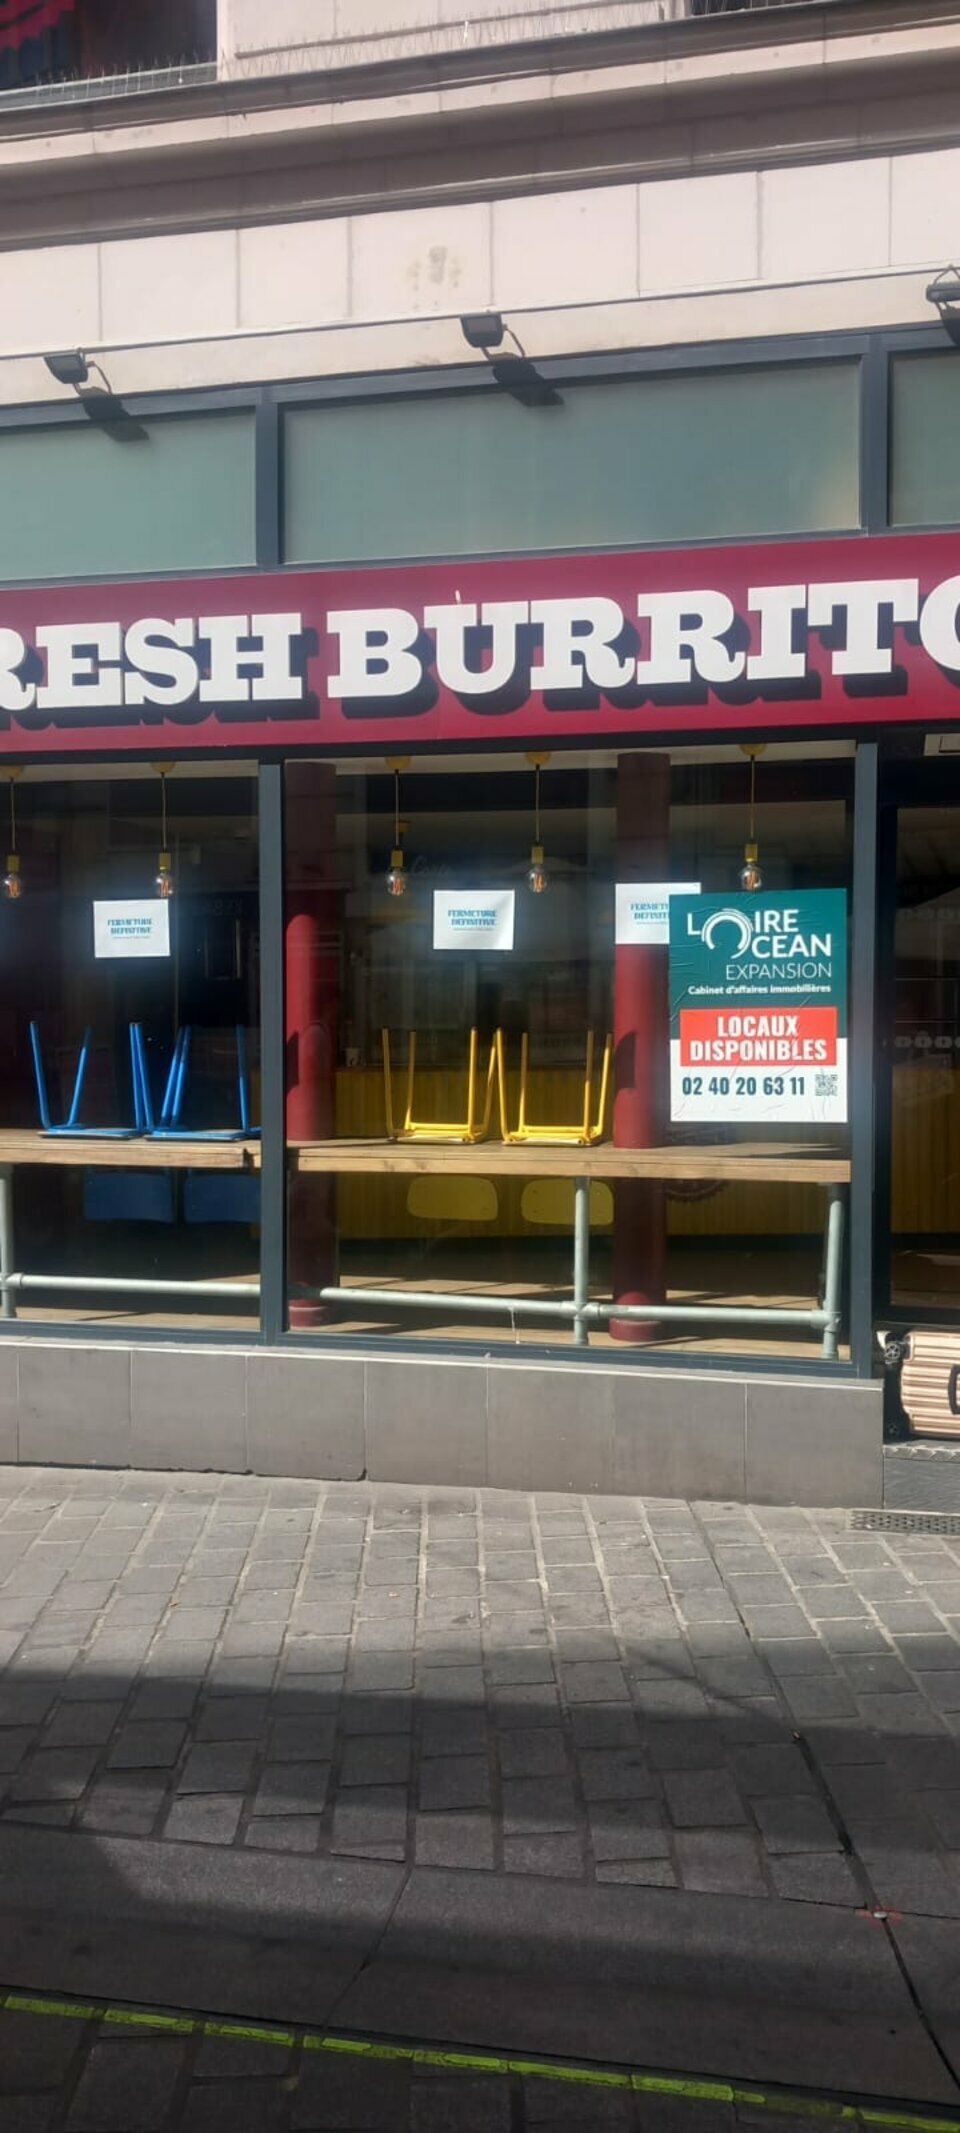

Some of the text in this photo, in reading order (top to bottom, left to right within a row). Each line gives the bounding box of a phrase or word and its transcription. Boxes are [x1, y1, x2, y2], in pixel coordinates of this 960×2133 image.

[107, 917, 152, 926] FERMETURE
[447, 909, 496, 917] FERMETURE
[725, 961, 832, 981] EXPANSION
[687, 983, 832, 995] Cabinet d'affaires immobilières
[717, 1015, 799, 1037] LOCAUX
[690, 1039, 828, 1061] DISPONIBLES
[682, 1076, 805, 1095] 02 40 20 63 11
